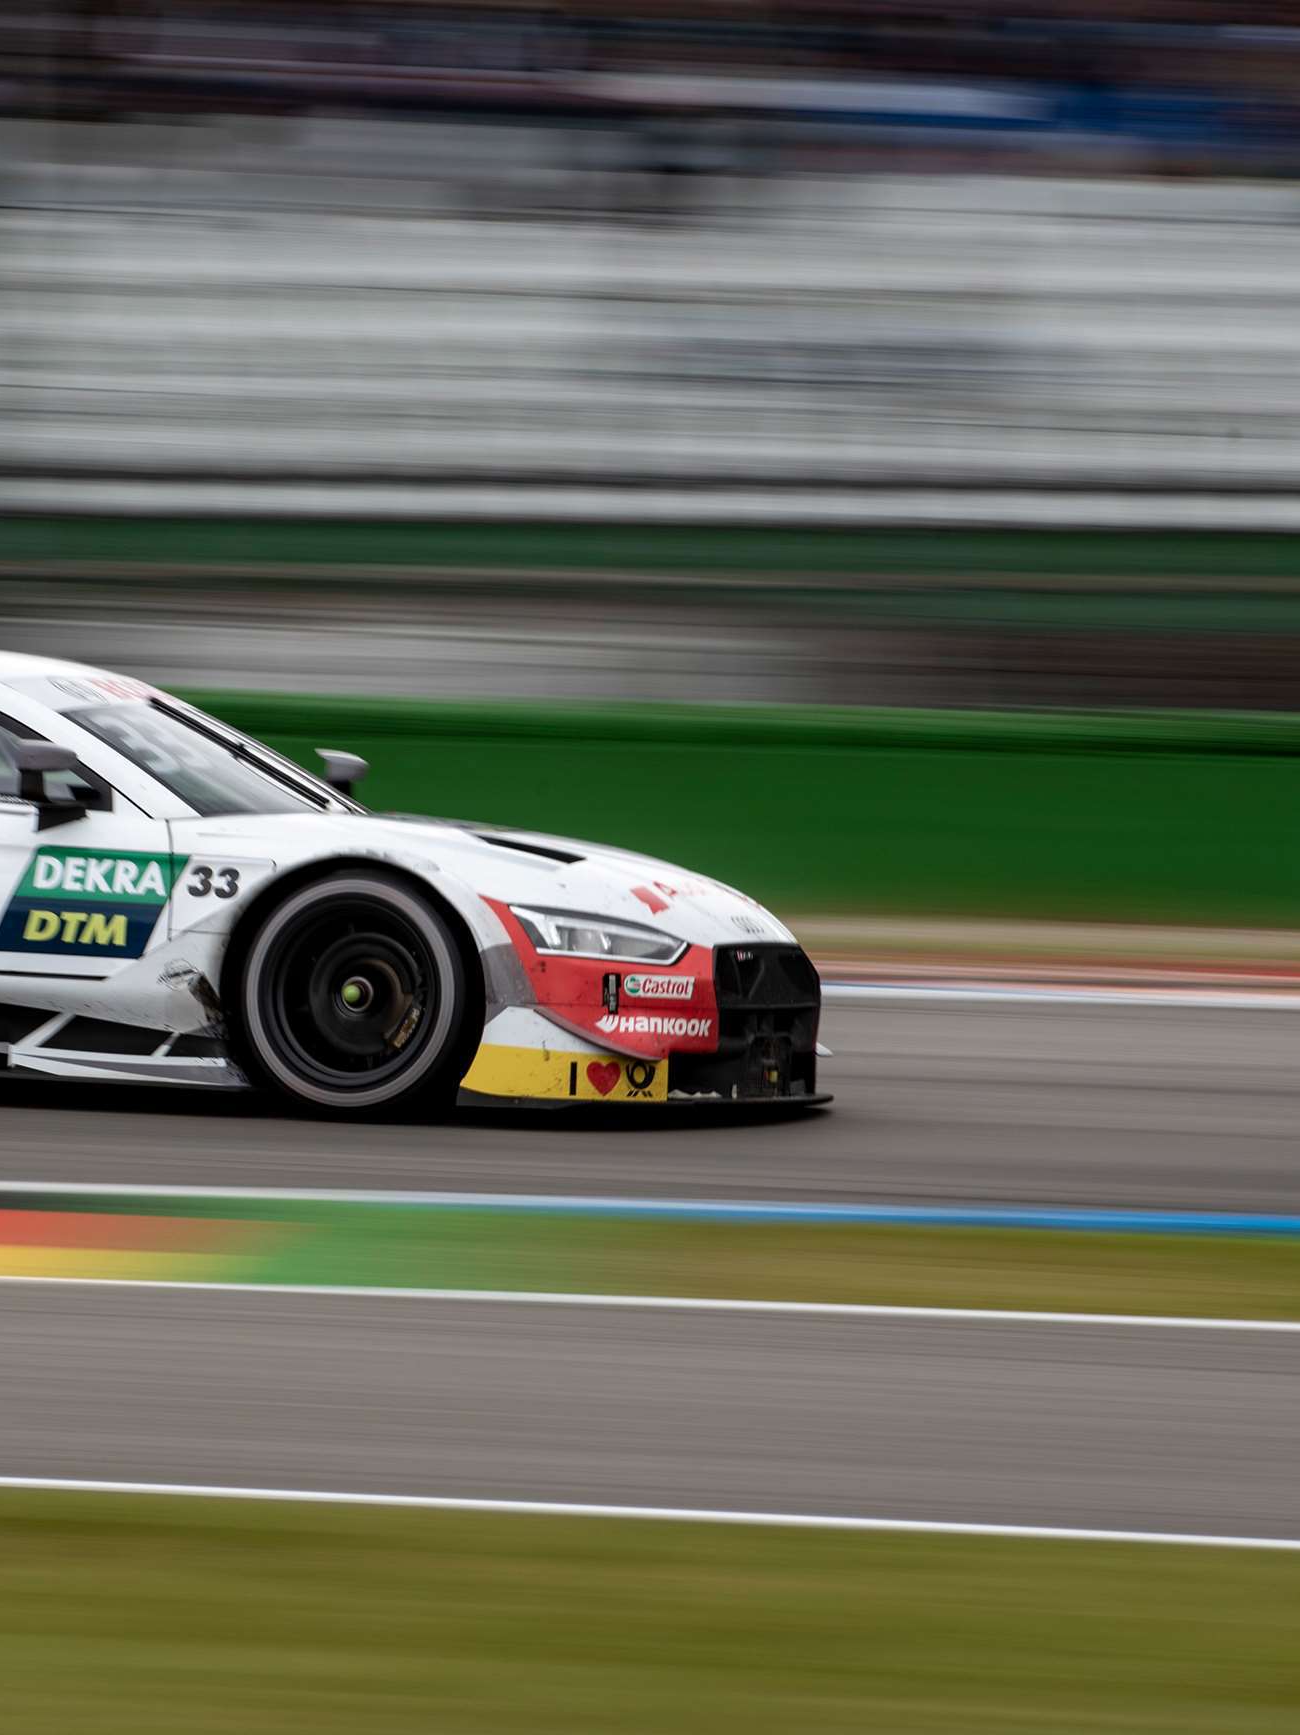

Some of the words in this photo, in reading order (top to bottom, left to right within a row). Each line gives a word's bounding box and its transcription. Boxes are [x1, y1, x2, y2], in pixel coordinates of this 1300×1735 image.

[33, 854, 167, 897] DEKRA
[187, 866, 240, 899] 33
[22, 909, 129, 947] DTM
[642, 978, 690, 996] Castrol
